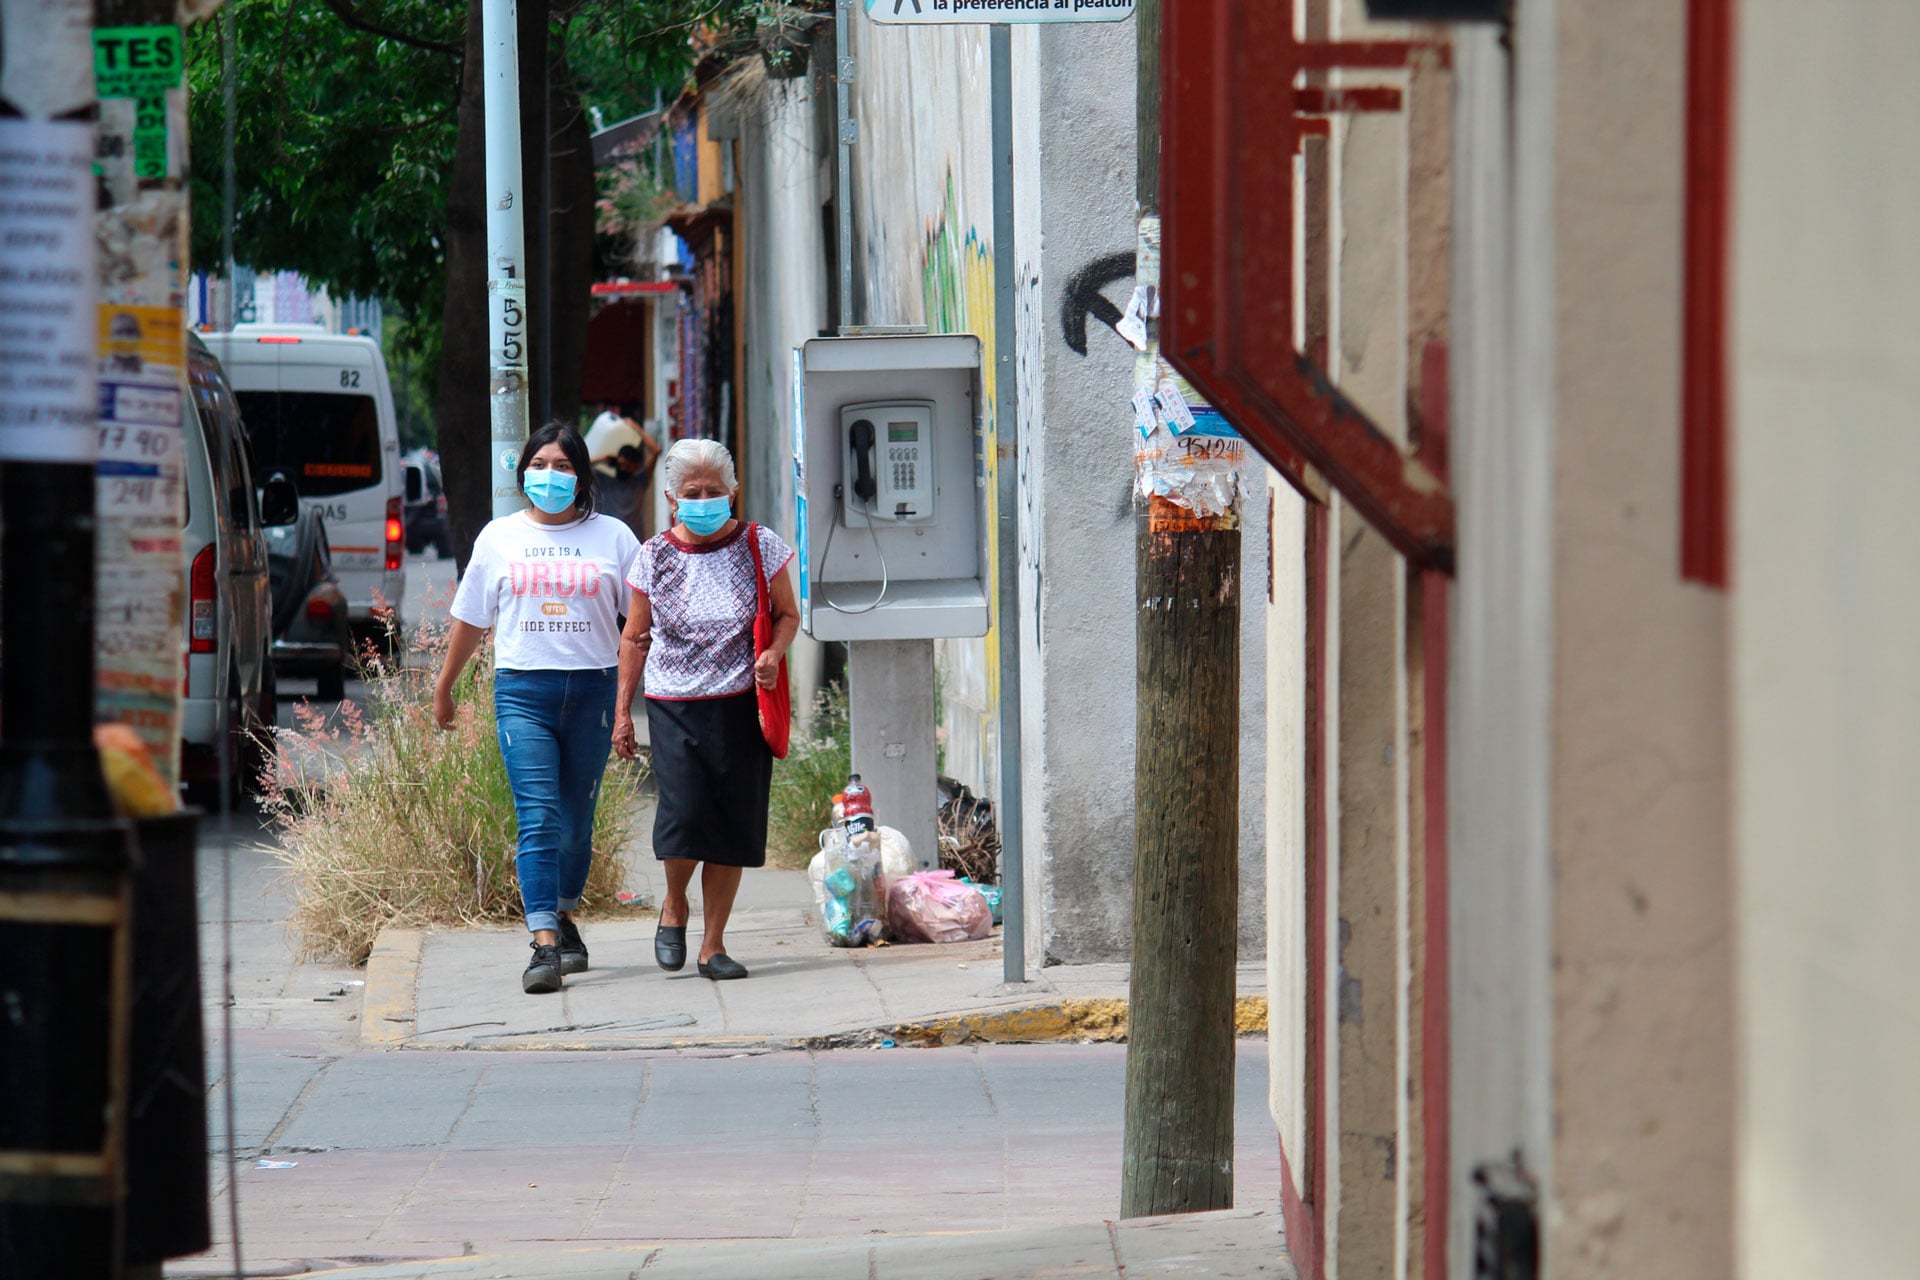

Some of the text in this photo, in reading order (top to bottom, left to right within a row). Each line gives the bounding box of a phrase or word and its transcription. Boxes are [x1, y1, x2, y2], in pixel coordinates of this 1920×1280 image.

[97, 36, 174, 69] TES
[340, 369, 361, 388] 82
[525, 547, 582, 558] LOVE IS A
[509, 562, 601, 598] DRUG
[519, 621, 592, 632] SIDE EFFECT
